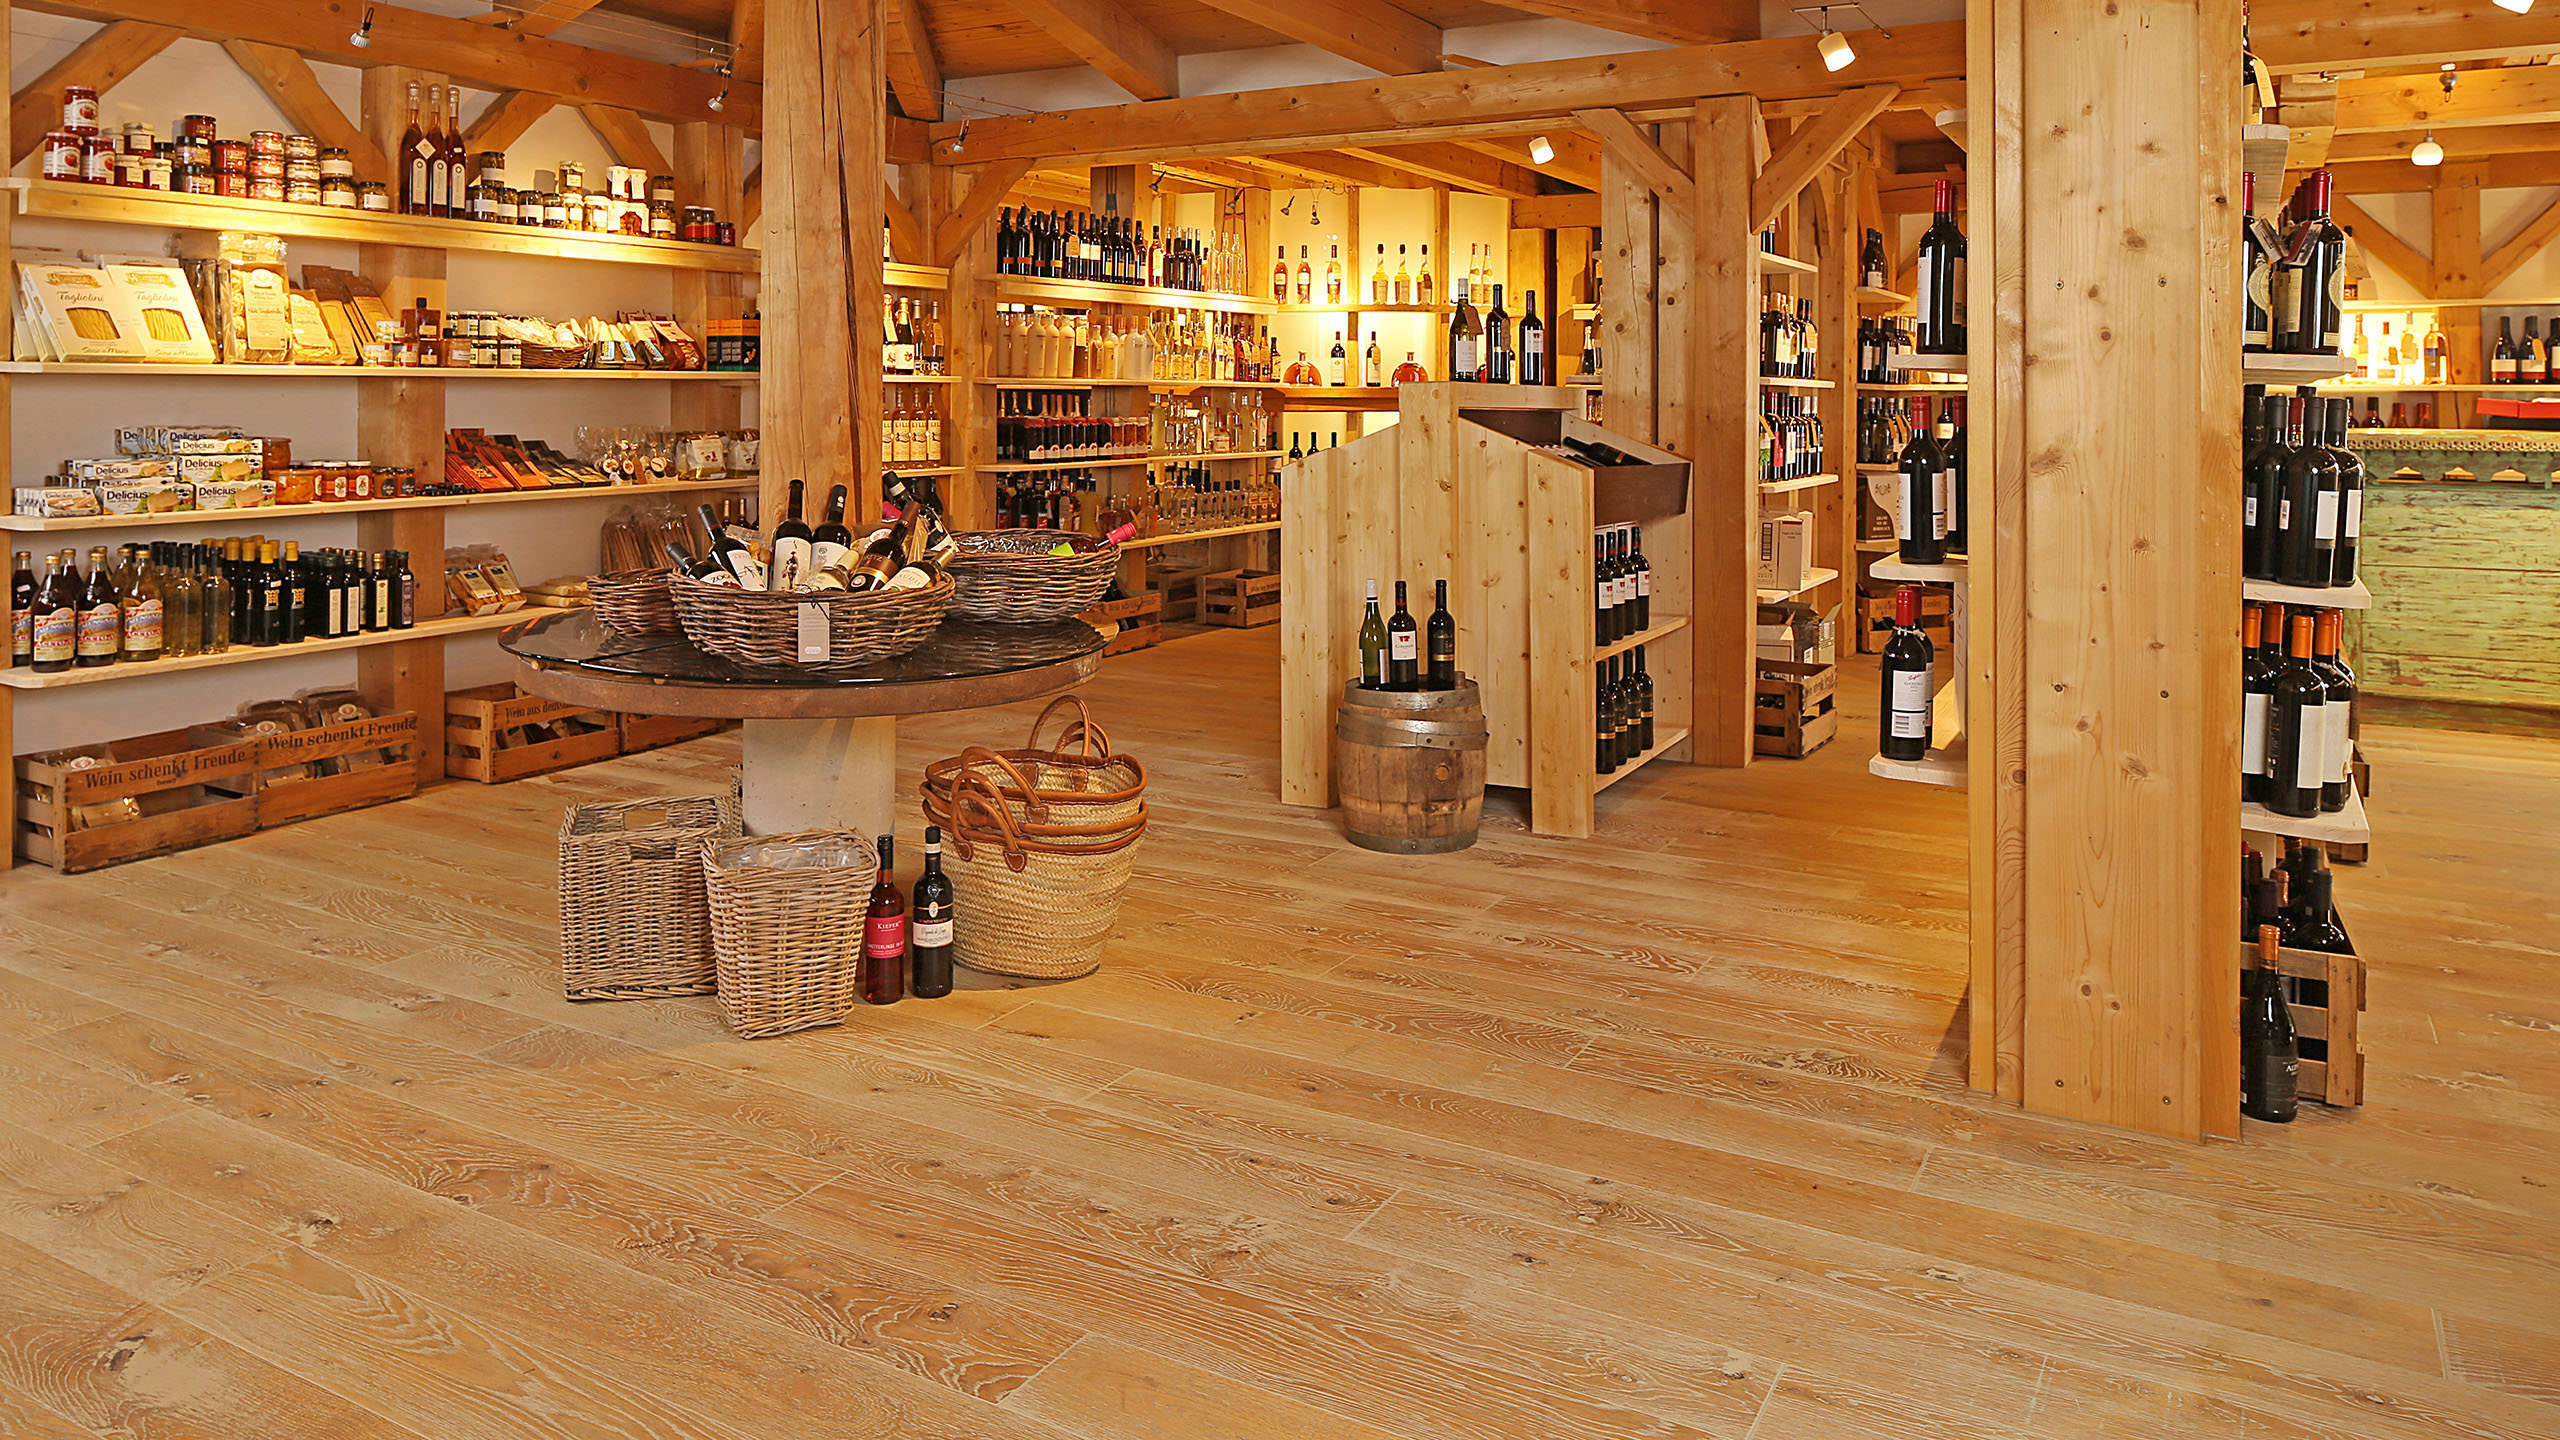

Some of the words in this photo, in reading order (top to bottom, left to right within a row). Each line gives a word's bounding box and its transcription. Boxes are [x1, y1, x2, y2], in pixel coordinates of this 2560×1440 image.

[57, 290, 105, 303] Tagliolini
[182, 441, 216, 450] Delicius
[184, 458, 223, 469] Delicius
[95, 466, 129, 476] Delicius
[106, 490, 149, 501] Delicius
[199, 486, 237, 497] Delicius
[267, 737, 304, 751] Wein
[307, 726, 365, 746] schenkt
[368, 716, 418, 736] Freude
[85, 771, 123, 789] Wein
[128, 759, 187, 781] schenkt
[193, 750, 246, 770] Freude
[877, 922, 900, 930] KIEFER
